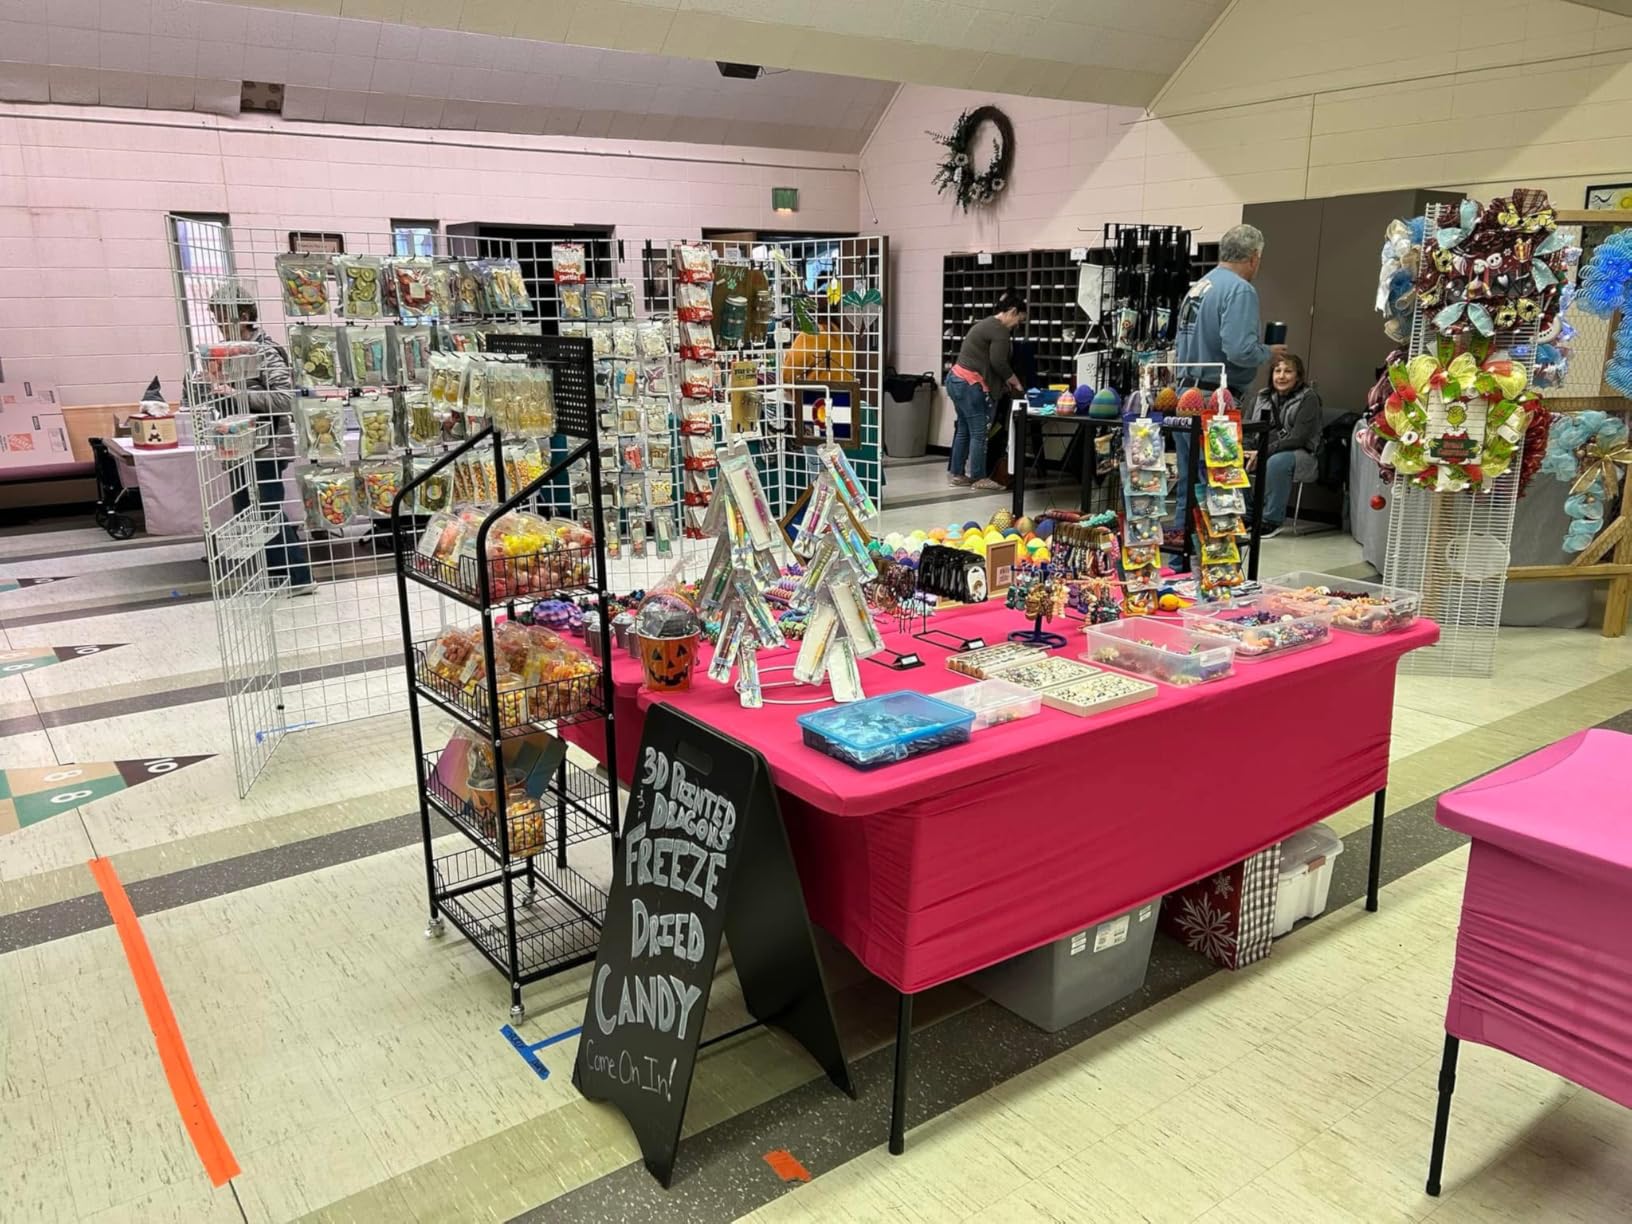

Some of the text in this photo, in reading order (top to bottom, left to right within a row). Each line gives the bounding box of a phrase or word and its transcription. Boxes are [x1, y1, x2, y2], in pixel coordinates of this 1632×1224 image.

[43, 768, 83, 782] 8
[50, 789, 93, 804] 8
[144, 757, 179, 774] 10
[641, 746, 736, 834] 3D PRINTED
[650, 792, 731, 851] DRAGONS
[626, 822, 727, 910] FREEZE
[632, 898, 705, 963] DRIED
[595, 963, 702, 1040] CANDY
[586, 1038, 677, 1102] Come On In!
